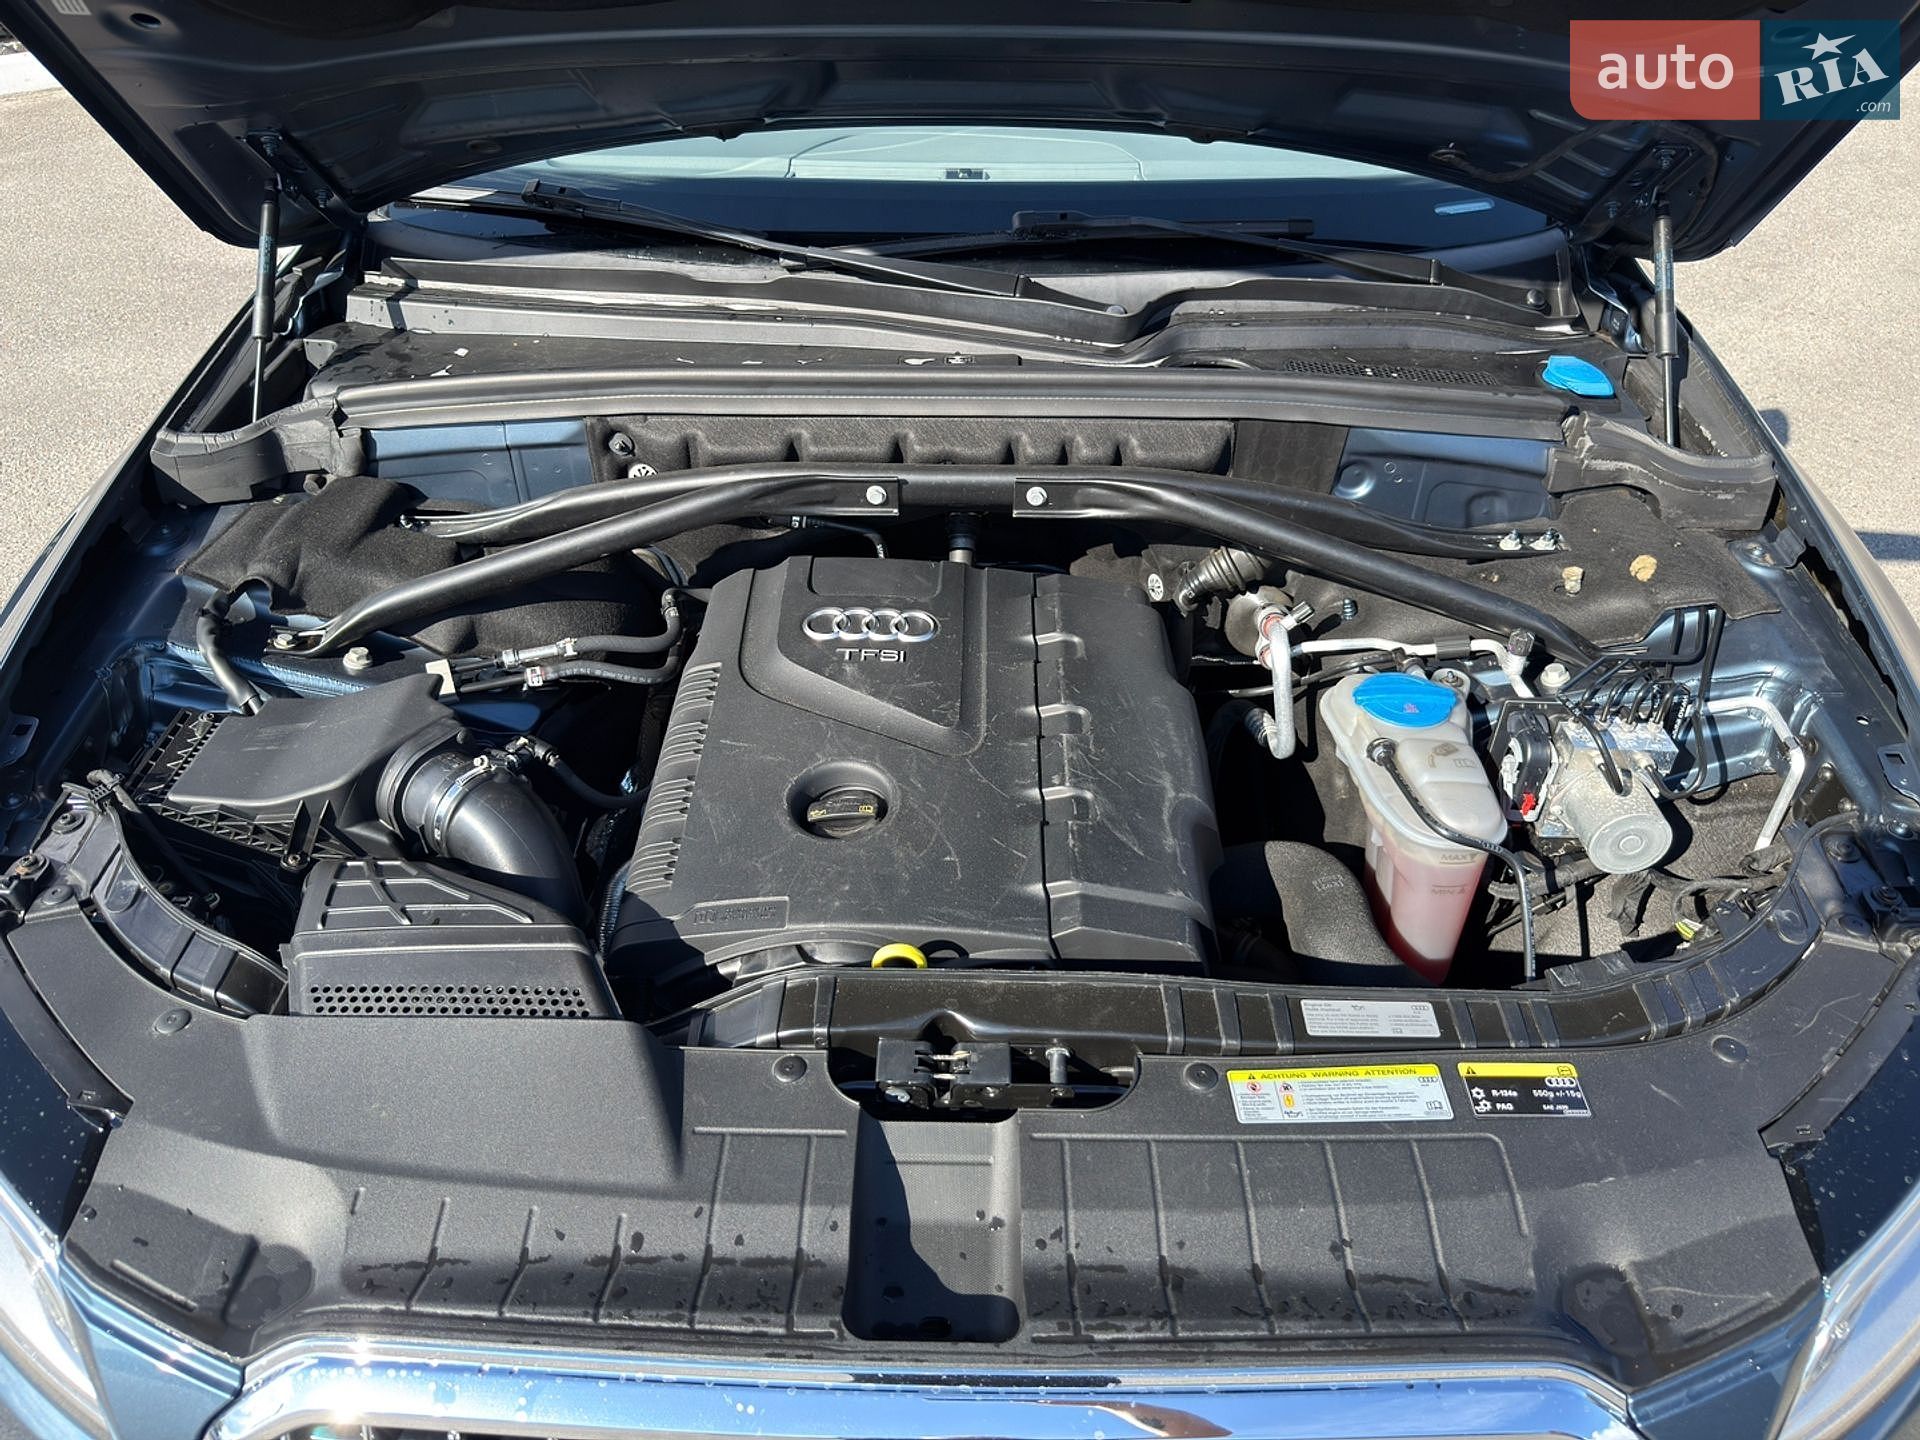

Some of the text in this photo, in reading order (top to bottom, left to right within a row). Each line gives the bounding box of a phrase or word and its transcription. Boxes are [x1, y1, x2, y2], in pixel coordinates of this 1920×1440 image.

[835, 648, 906, 663] TFSI
[1260, 1067, 1417, 1080] ACHTUNG WARNING ATTENTION
[1491, 1089, 1518, 1097] R-134a
[1495, 1103, 1514, 1111] PAG
